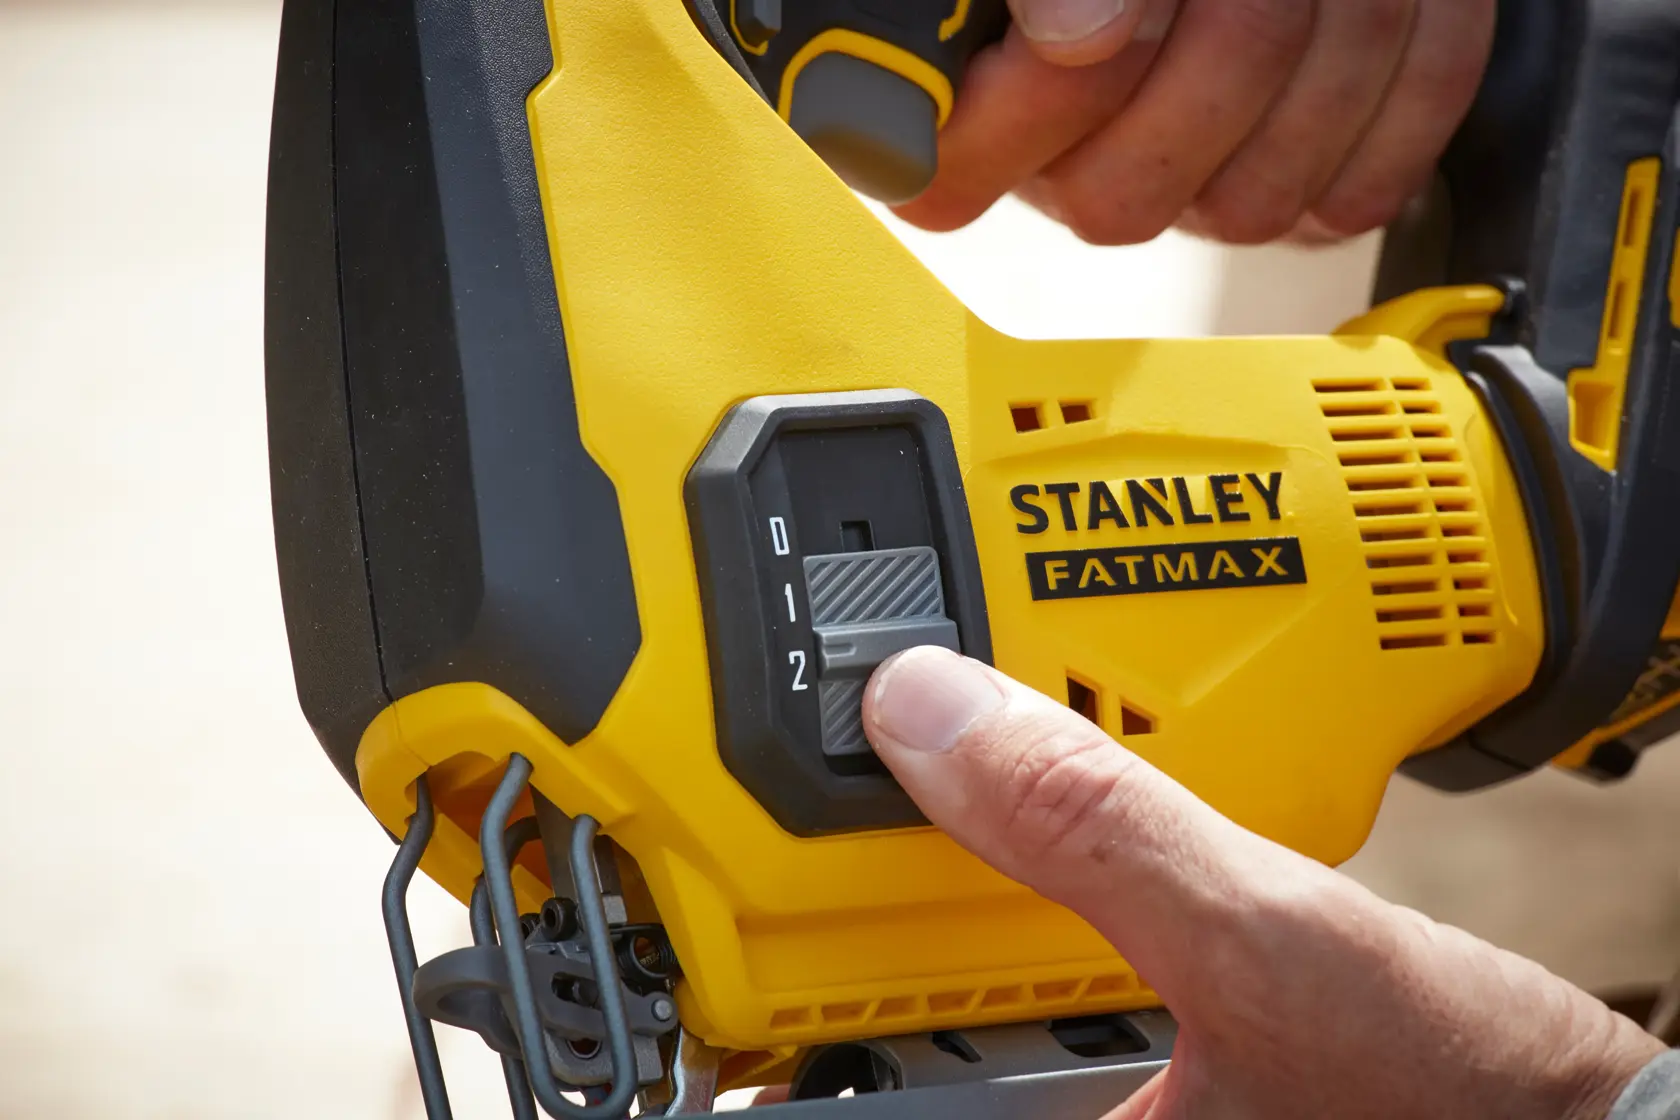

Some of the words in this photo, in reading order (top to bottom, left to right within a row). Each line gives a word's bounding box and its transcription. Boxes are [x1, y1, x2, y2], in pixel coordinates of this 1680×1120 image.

[1009, 472, 1282, 534] STANLEY
[769, 516, 790, 556] 0
[1044, 546, 1289, 590] FATMAX
[784, 583, 796, 622] 1
[788, 650, 808, 691] 2
